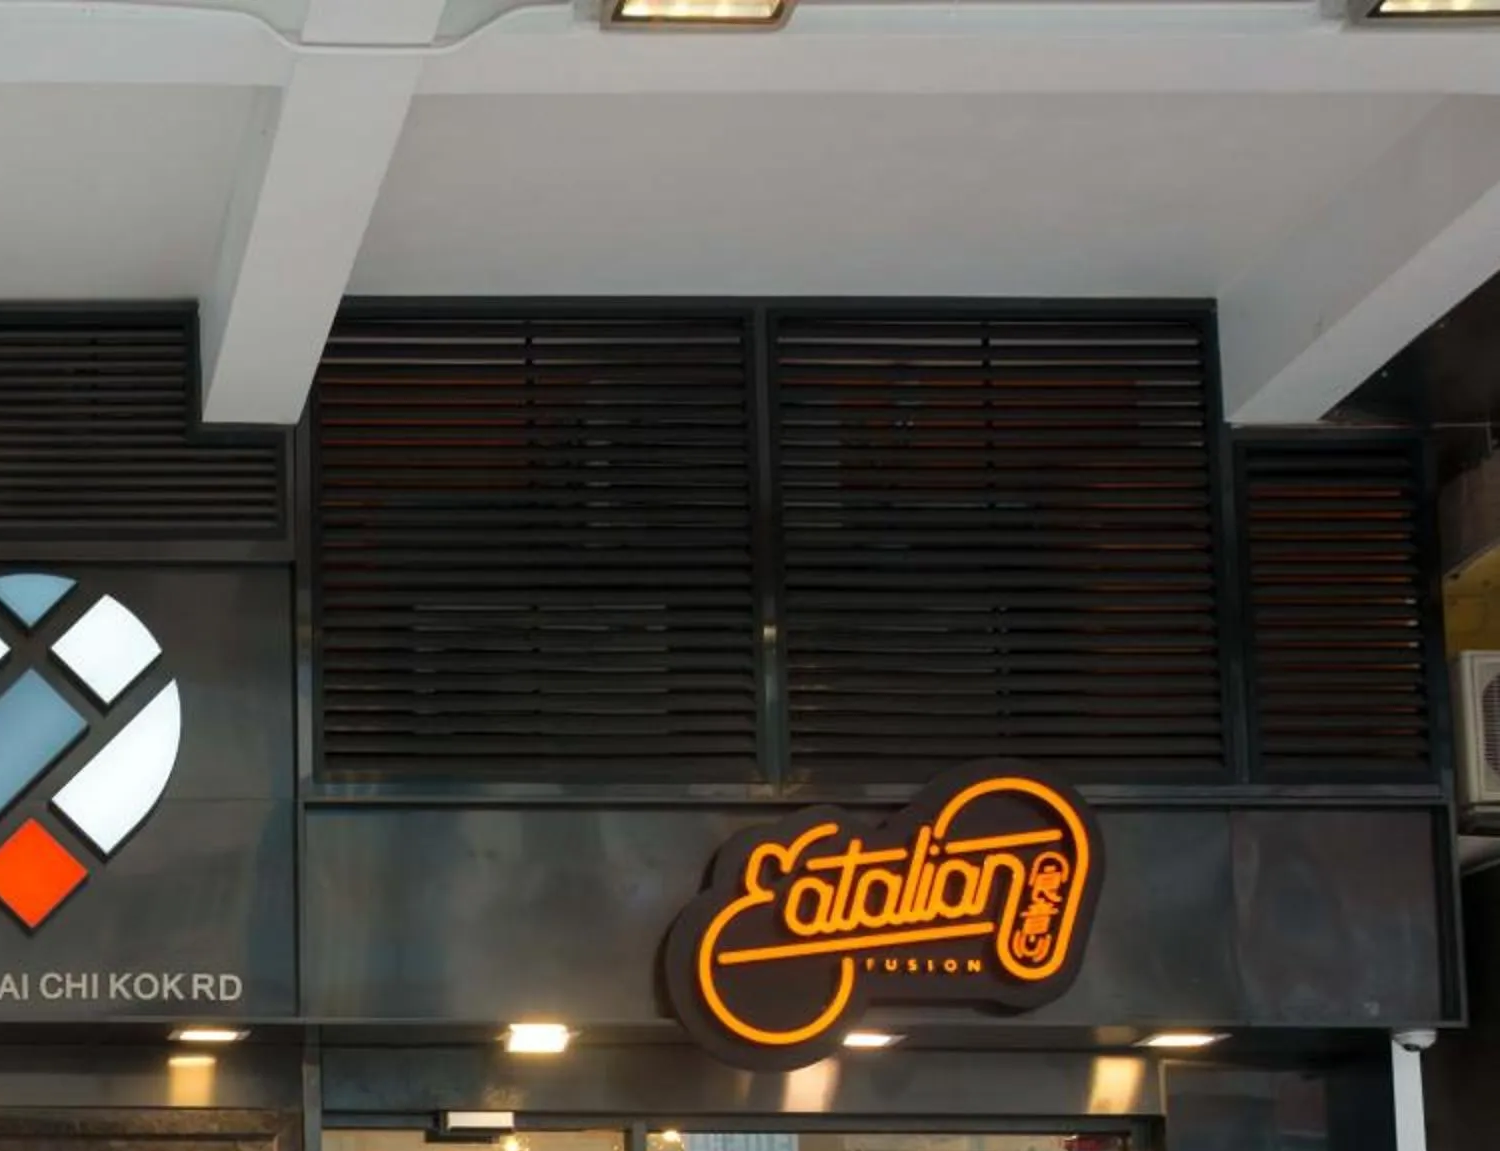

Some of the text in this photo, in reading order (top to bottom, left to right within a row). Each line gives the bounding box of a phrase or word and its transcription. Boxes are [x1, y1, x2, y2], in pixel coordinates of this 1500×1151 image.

[864, 957, 983, 973] FUSION
[39, 973, 98, 1000] CHI
[109, 973, 185, 1001] KOK
[191, 974, 242, 1001] RD
